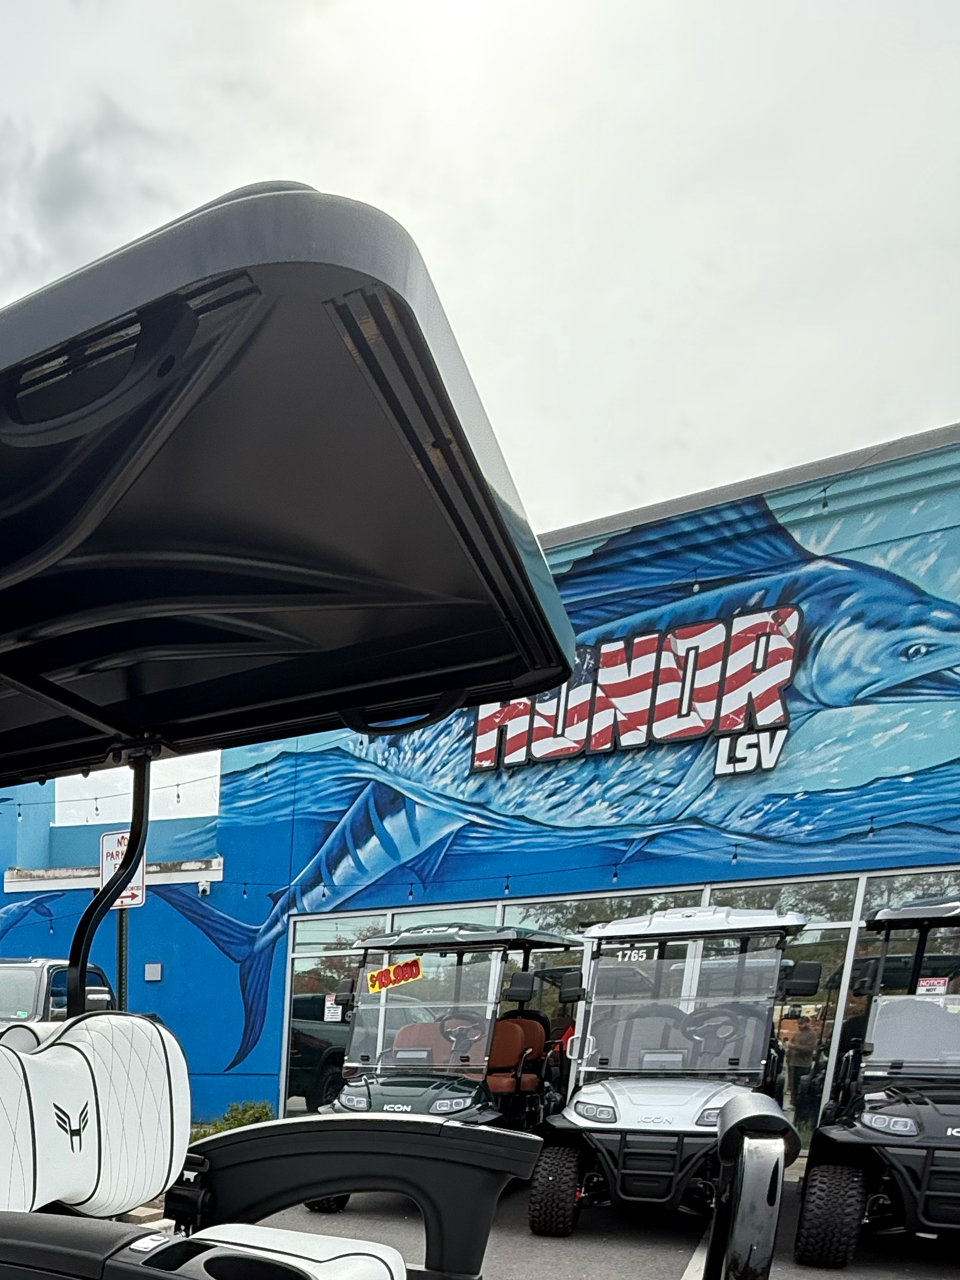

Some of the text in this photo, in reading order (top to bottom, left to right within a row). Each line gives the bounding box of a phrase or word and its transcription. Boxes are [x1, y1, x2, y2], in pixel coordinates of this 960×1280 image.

[714, 728, 788, 776] LSV
[106, 850, 127, 861] PARK
[616, 949, 647, 962] 1765
[919, 979, 946, 987] NOTICE
[383, 1104, 412, 1112] ICON
[637, 1115, 673, 1125] ICON
